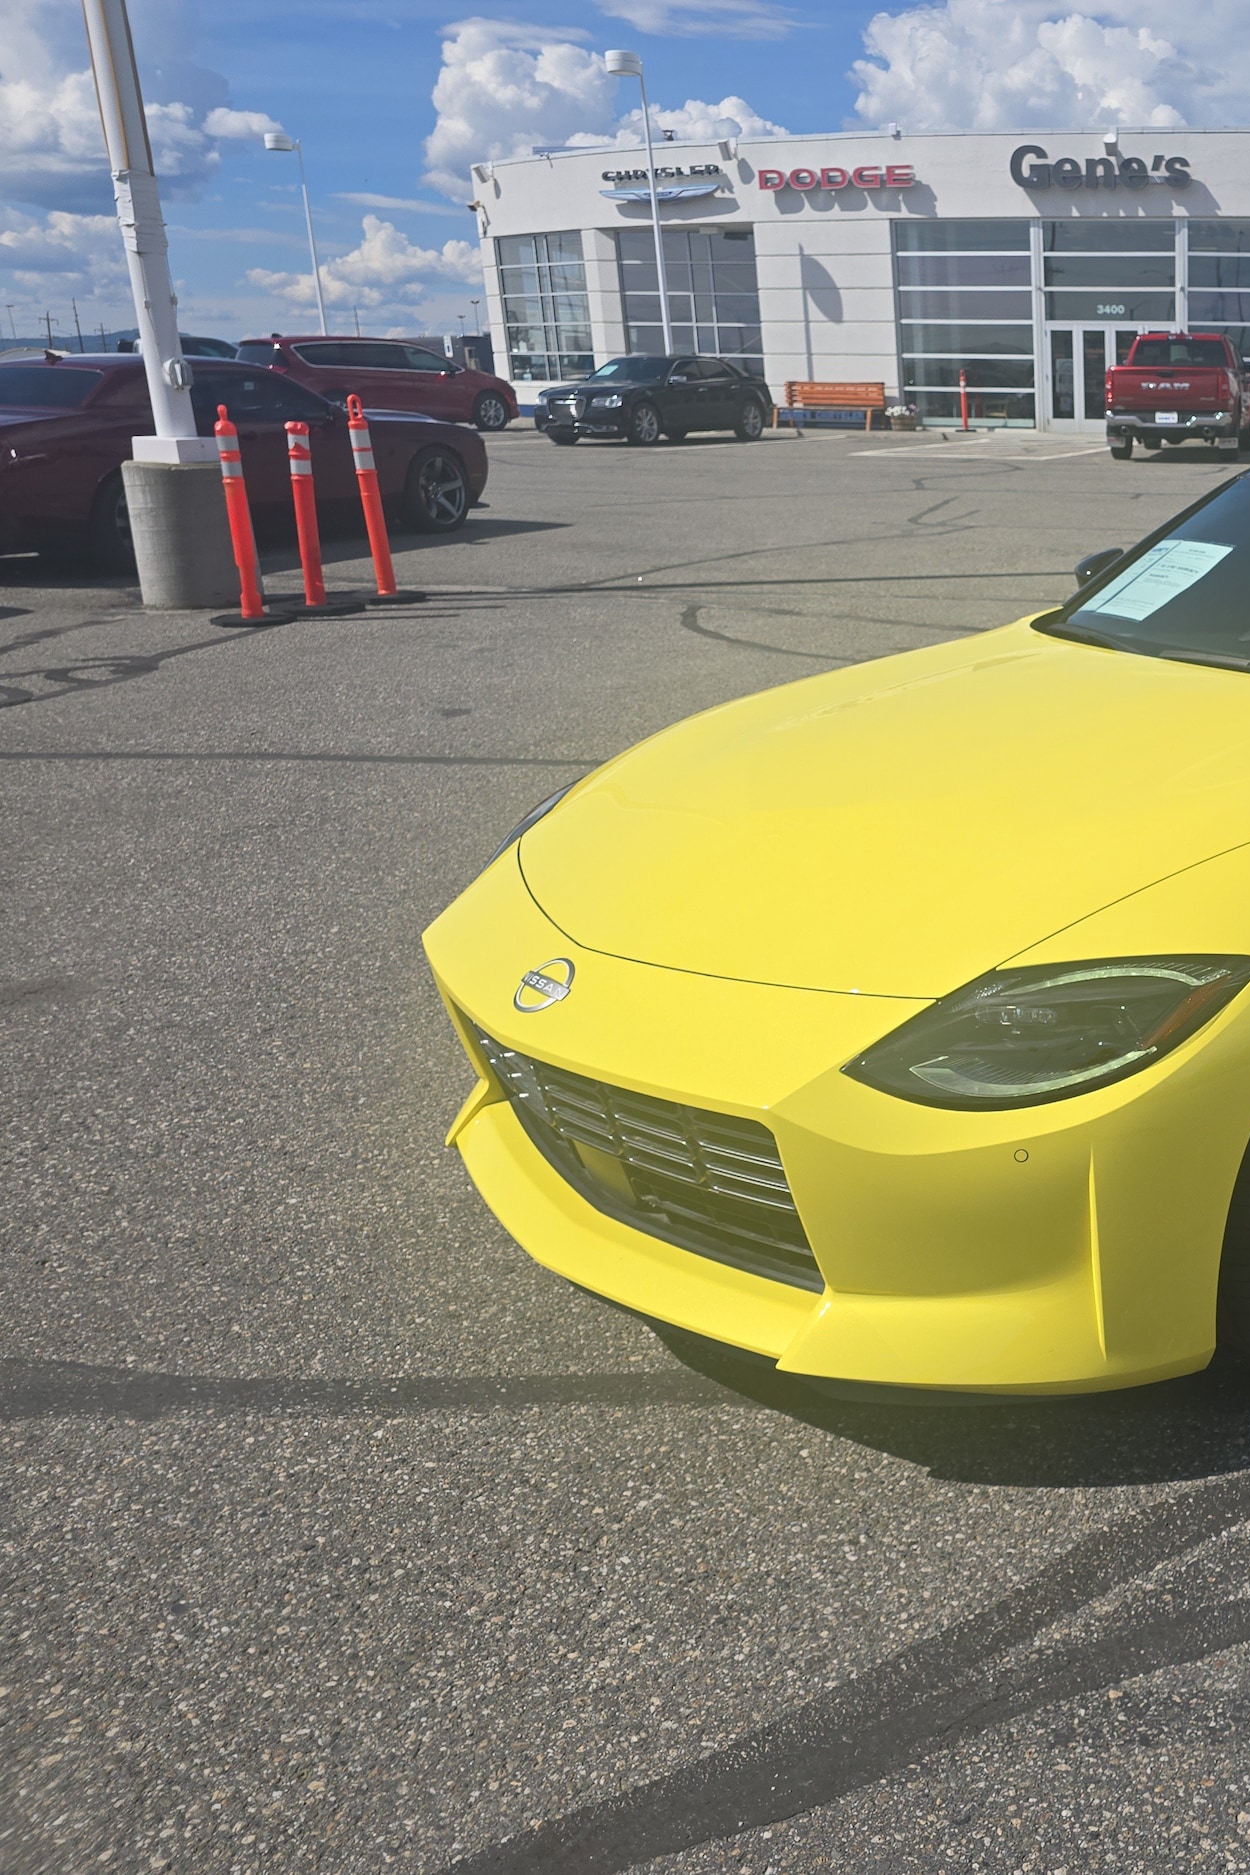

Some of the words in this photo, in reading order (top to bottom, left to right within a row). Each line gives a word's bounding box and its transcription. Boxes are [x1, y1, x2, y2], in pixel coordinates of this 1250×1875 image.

[759, 164, 915, 190] DODGE
[1010, 145, 1192, 190] Gene's
[1096, 304, 1125, 314] 3400
